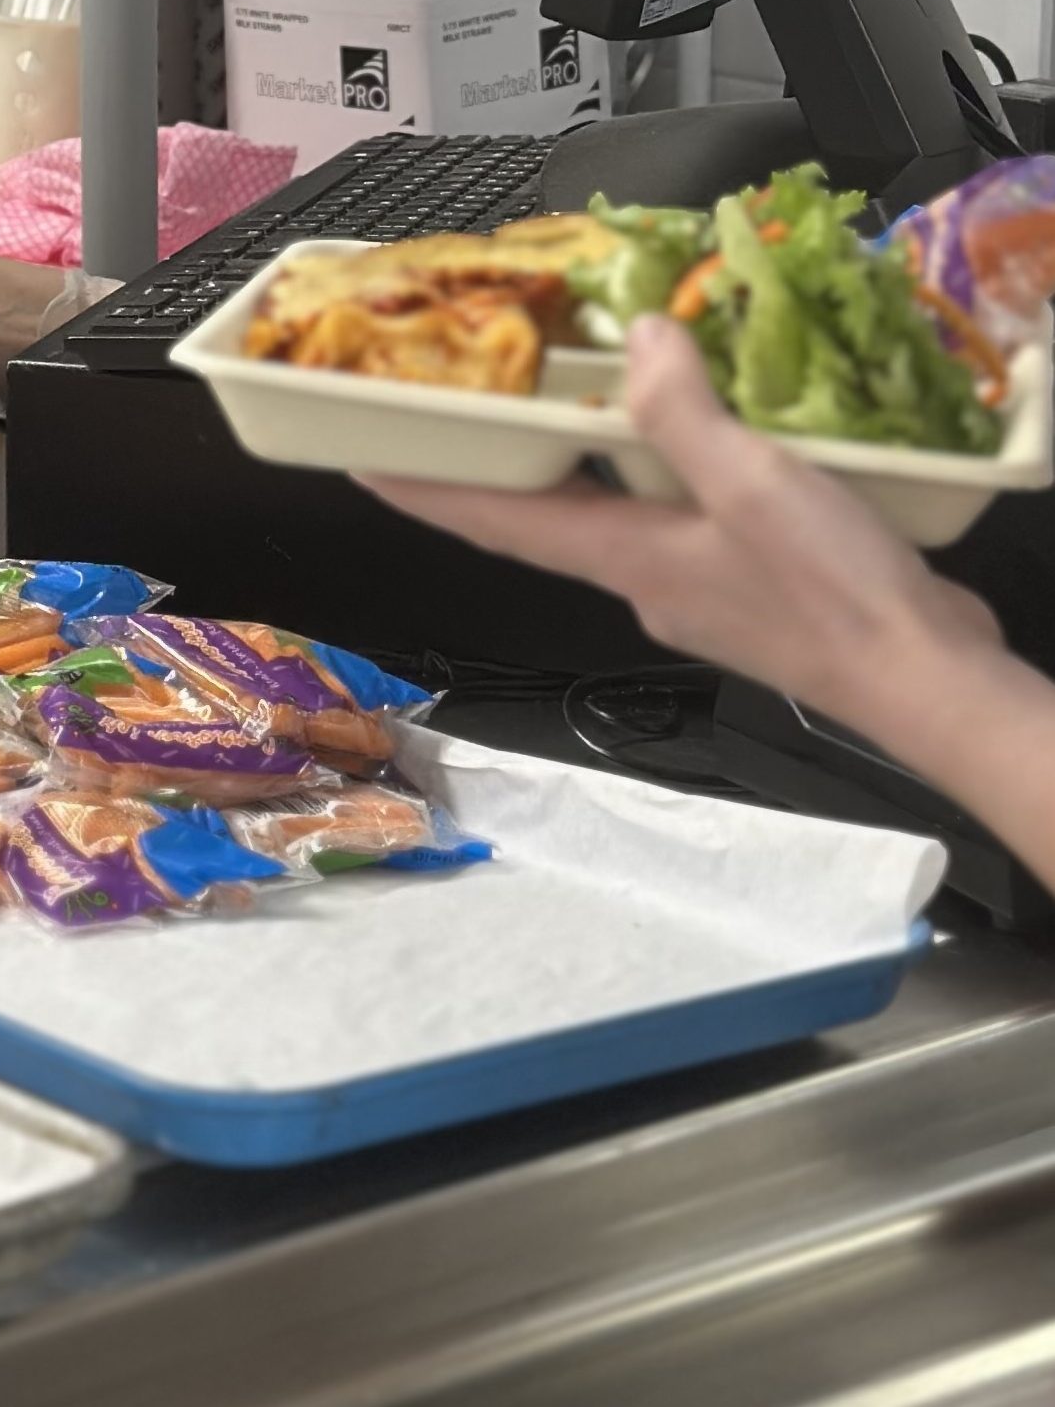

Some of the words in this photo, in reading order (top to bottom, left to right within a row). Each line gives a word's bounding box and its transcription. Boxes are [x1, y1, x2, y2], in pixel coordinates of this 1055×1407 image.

[249, 9, 271, 20] WHITE
[272, 12, 309, 24] WRAPPED
[458, 16, 481, 28] WHITE
[482, 8, 518, 23] WRAPPED
[235, 19, 251, 29] MILK
[252, 21, 282, 33] STRAWS
[442, 33, 460, 43] MILK
[462, 26, 492, 40] STRAWS
[256, 72, 338, 105] Market
[343, 83, 387, 111] PRO
[460, 68, 538, 108] Market
[542, 60, 579, 89] PRO
